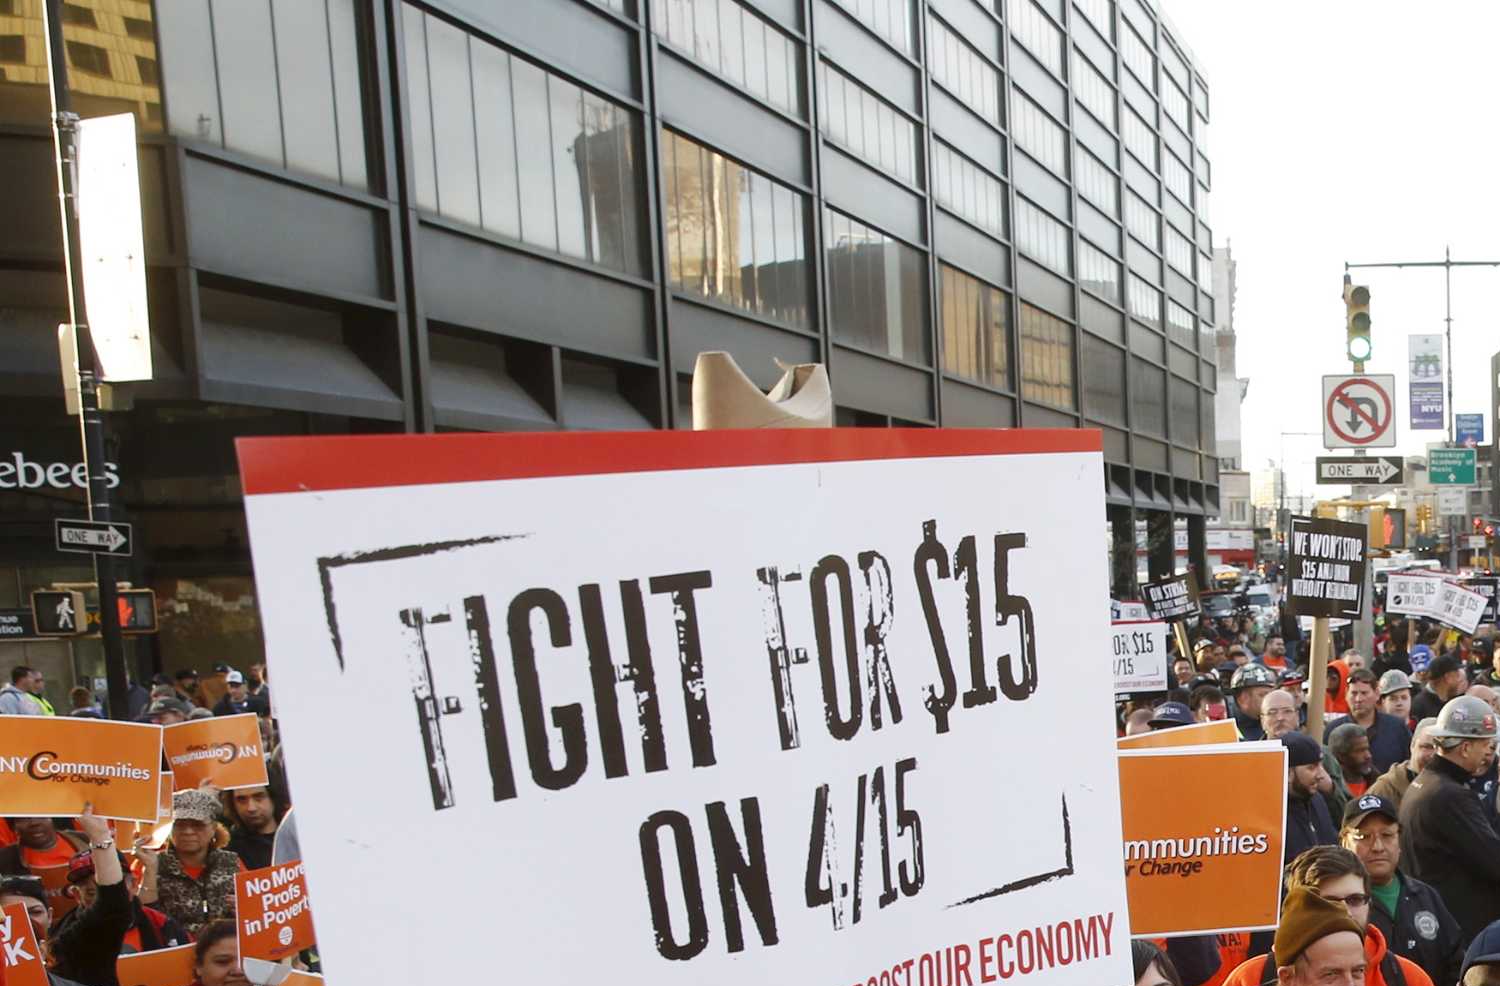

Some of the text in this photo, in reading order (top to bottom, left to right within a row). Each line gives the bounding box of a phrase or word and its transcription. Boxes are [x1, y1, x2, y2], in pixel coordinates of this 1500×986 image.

[1421, 404, 1442, 413] NYU
[1328, 465, 1391, 476] ONE WAY
[67, 530, 120, 544] ONE WAY
[1294, 531, 1309, 556] WE
[1113, 631, 1154, 656] OR $15
[400, 519, 1039, 812] FIGHT FOR $15
[239, 744, 257, 758] NY
[0, 751, 151, 781] NY Communities
[1123, 826, 1268, 860] mmunities
[638, 757, 928, 961] ON 4/15
[1140, 858, 1203, 877] Change
[245, 876, 271, 898] No
[262, 883, 302, 911] Profs
[244, 895, 311, 937] in Povert
[978, 912, 1116, 986] ECONOMY
